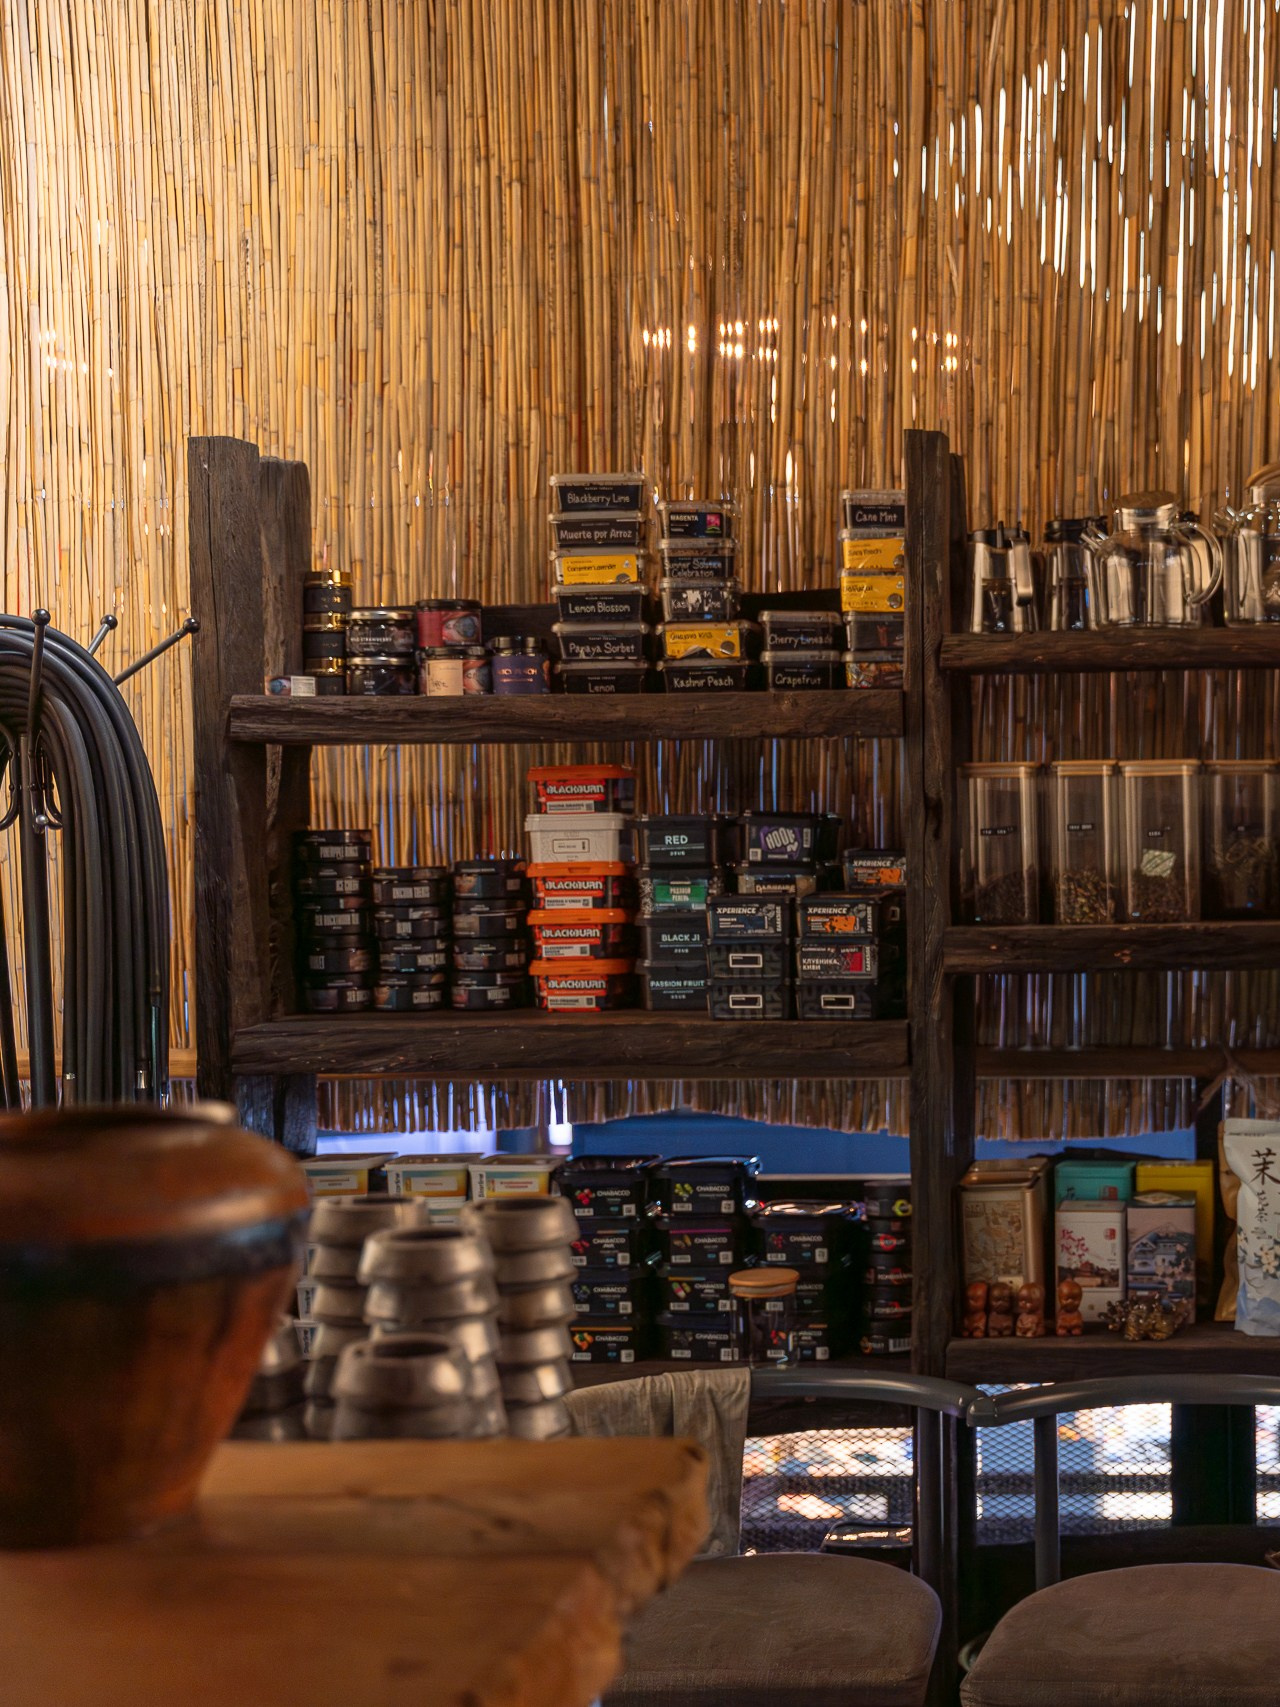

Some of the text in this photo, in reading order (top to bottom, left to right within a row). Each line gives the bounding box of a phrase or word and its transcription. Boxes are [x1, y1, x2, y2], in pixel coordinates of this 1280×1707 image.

[567, 492, 611, 506] Blackberry
[670, 514, 699, 523] MAGENTA
[855, 510, 877, 522] Cane
[560, 528, 633, 541] Muerte por Arroz
[597, 602, 631, 613] Blossom
[604, 641, 636, 654] Sorbet
[707, 675, 734, 687] Peach
[774, 674, 822, 688] Grapefruit
[588, 681, 616, 693] Lemon
[546, 784, 604, 796] BLACKBURN
[664, 835, 688, 845] RED
[852, 859, 892, 867] XPERIENCE
[545, 879, 604, 890] BLACKBURN
[716, 906, 757, 915] XPERIENCE
[807, 906, 848, 915] XPERIENCE
[542, 928, 601, 939] BLACKBURN
[661, 933, 690, 942] BLACK
[547, 978, 607, 990] BLACKBURN
[650, 980, 682, 988] PASSION
